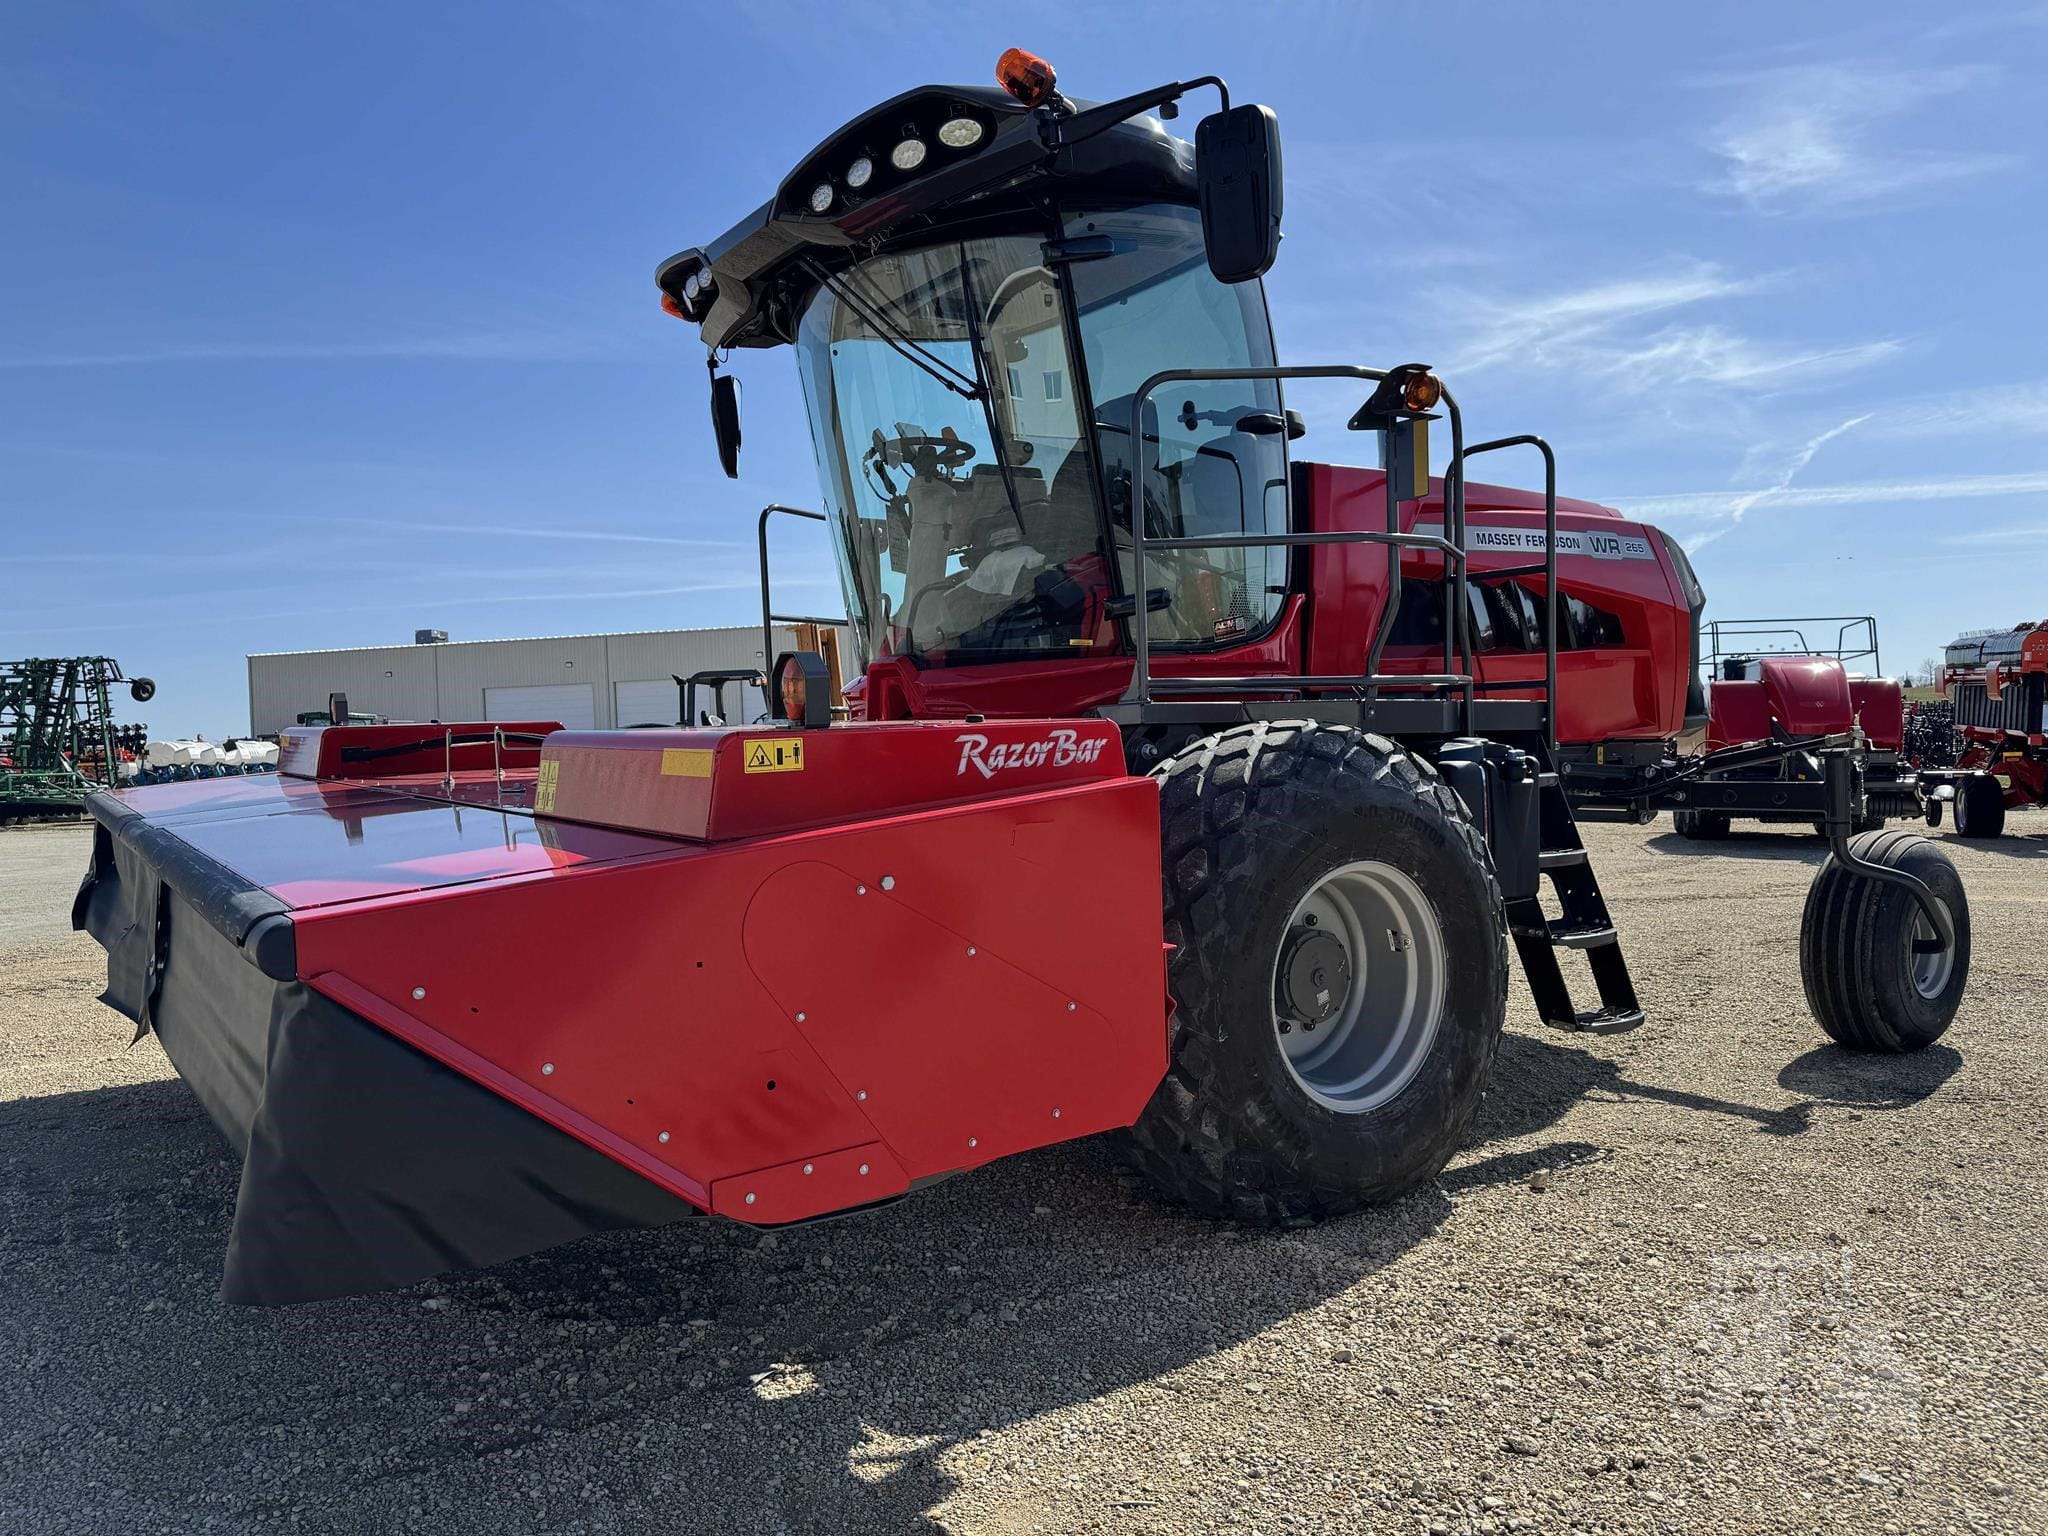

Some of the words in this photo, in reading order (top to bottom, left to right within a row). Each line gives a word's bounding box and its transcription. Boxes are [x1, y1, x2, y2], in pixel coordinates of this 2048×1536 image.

[1476, 532, 1521, 547] MASSEY
[1526, 534, 1581, 549] FERUSON
[1589, 536, 1622, 555] WR
[1625, 542, 1645, 553] 265
[1390, 806, 1446, 846] TRACTOR
